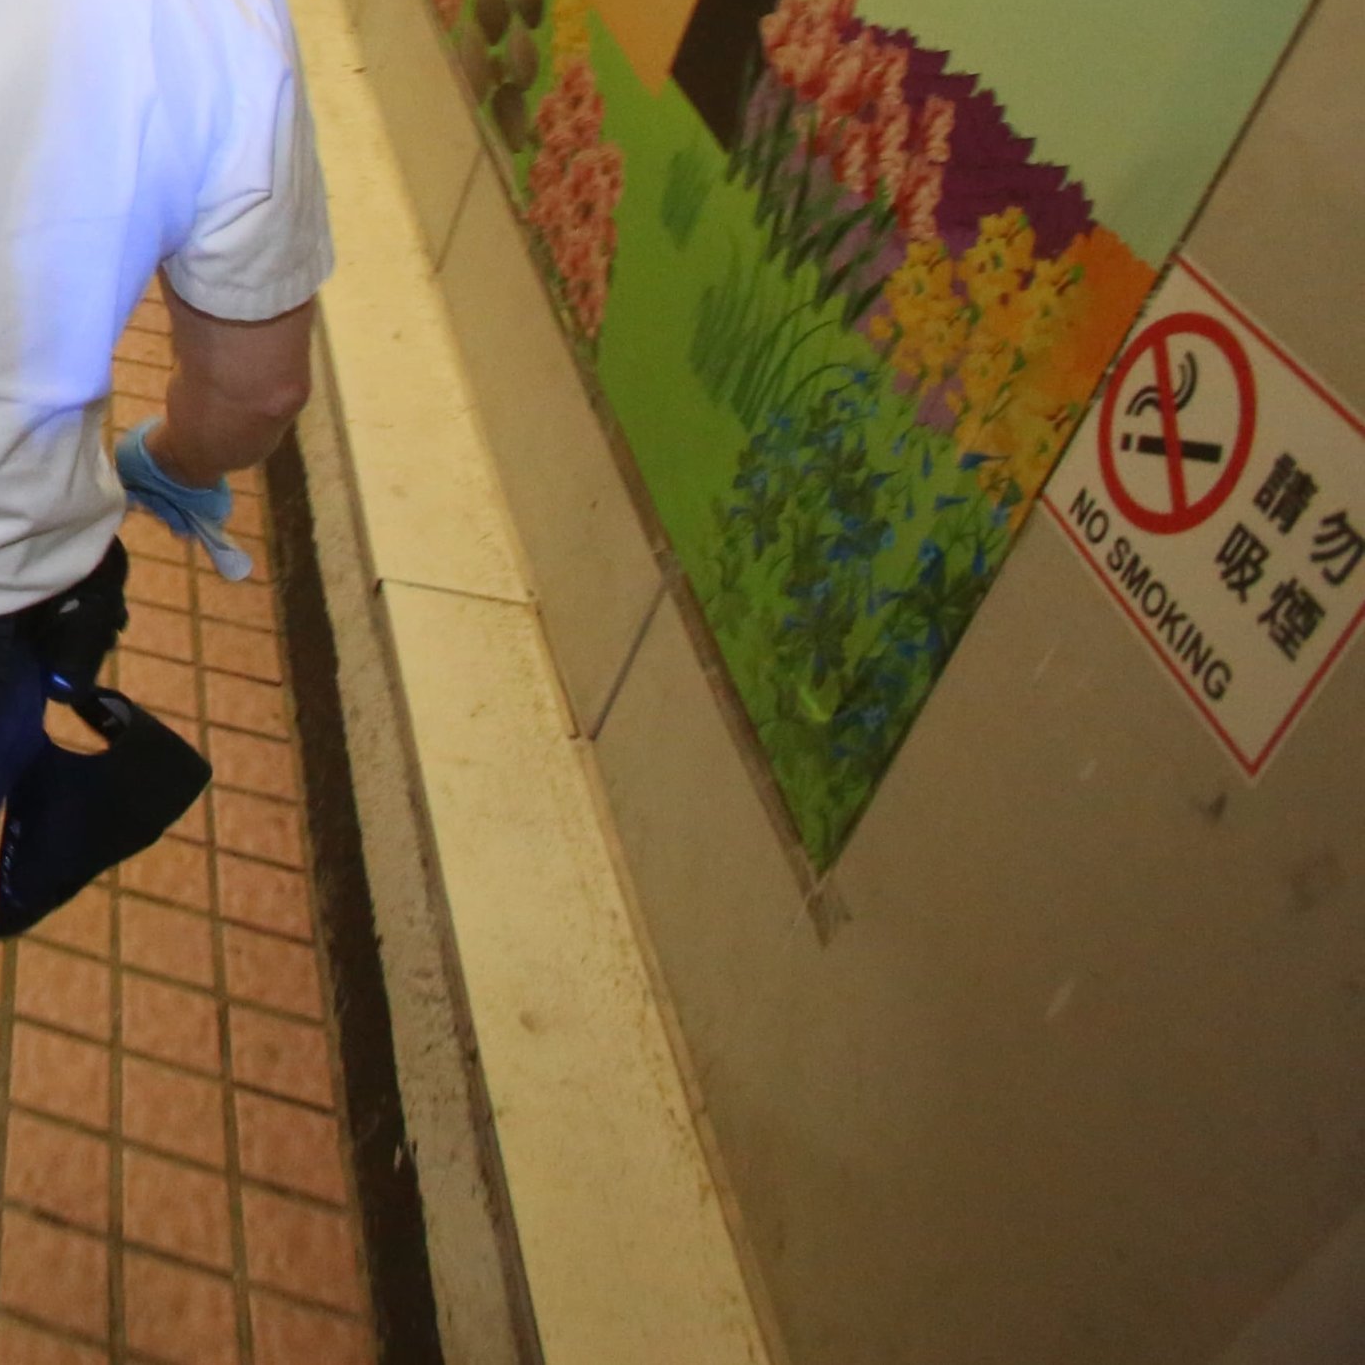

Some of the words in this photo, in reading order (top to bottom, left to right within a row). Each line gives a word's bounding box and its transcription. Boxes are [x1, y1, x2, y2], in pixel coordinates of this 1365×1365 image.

[1253, 451, 1365, 586] 請勿
[1069, 487, 1111, 545] NO
[1105, 536, 1233, 702] SMOKING
[1215, 522, 1326, 663] 吸煙
